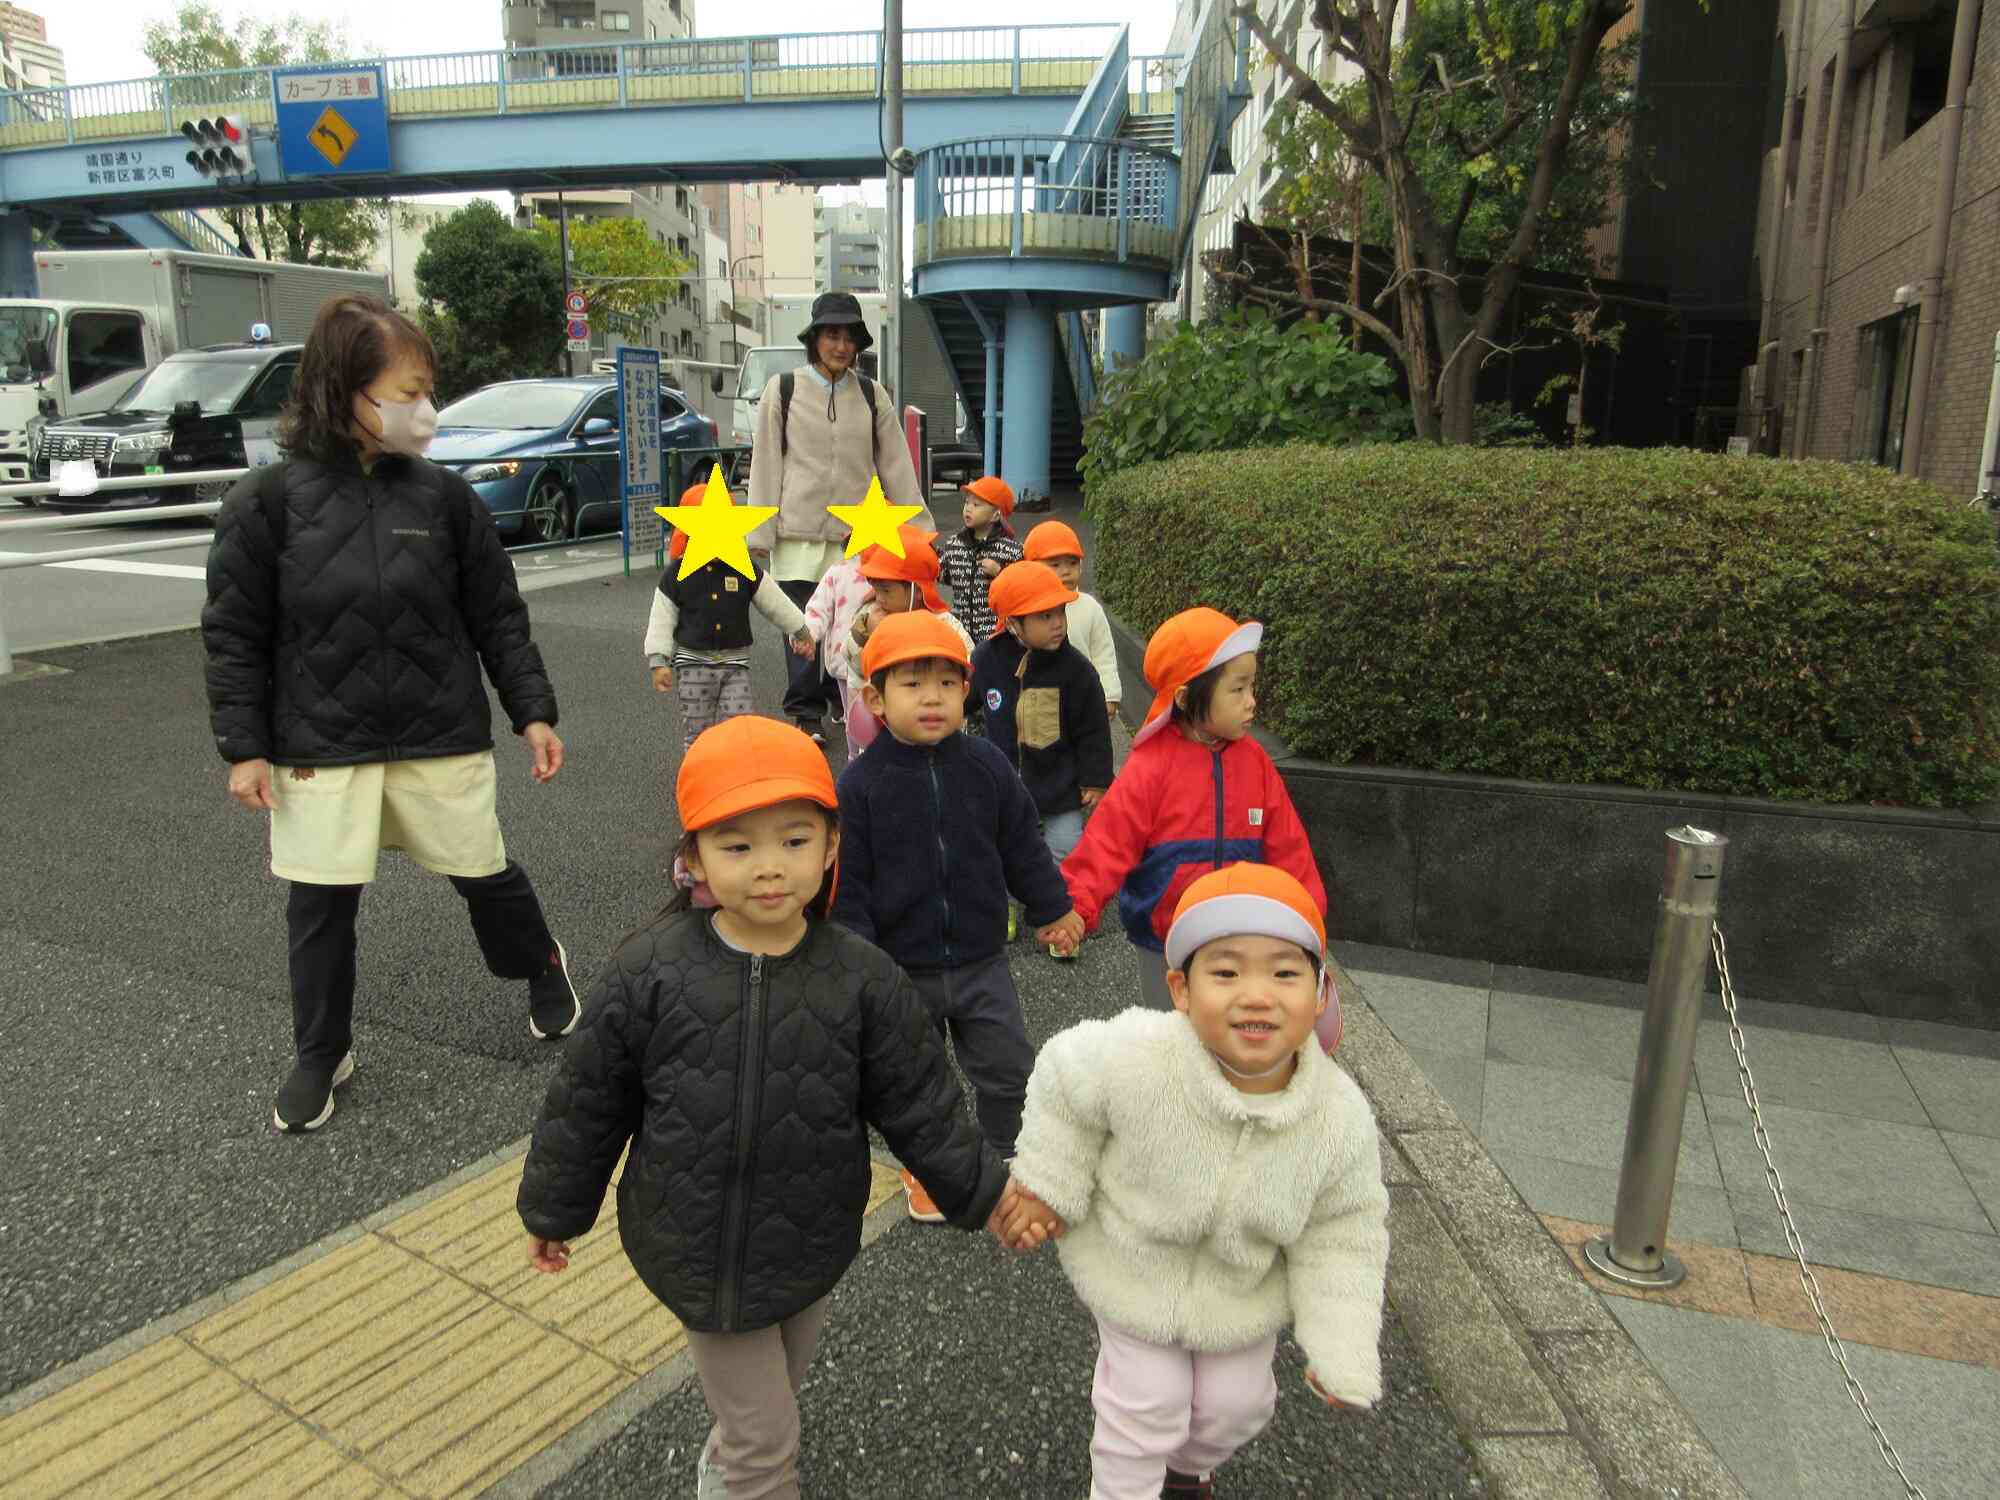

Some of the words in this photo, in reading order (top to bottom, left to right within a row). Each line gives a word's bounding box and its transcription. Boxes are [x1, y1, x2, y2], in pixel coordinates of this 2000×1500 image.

[86, 151, 142, 167] 靖国通り
[88, 166, 175, 184] 新宿区富久町
